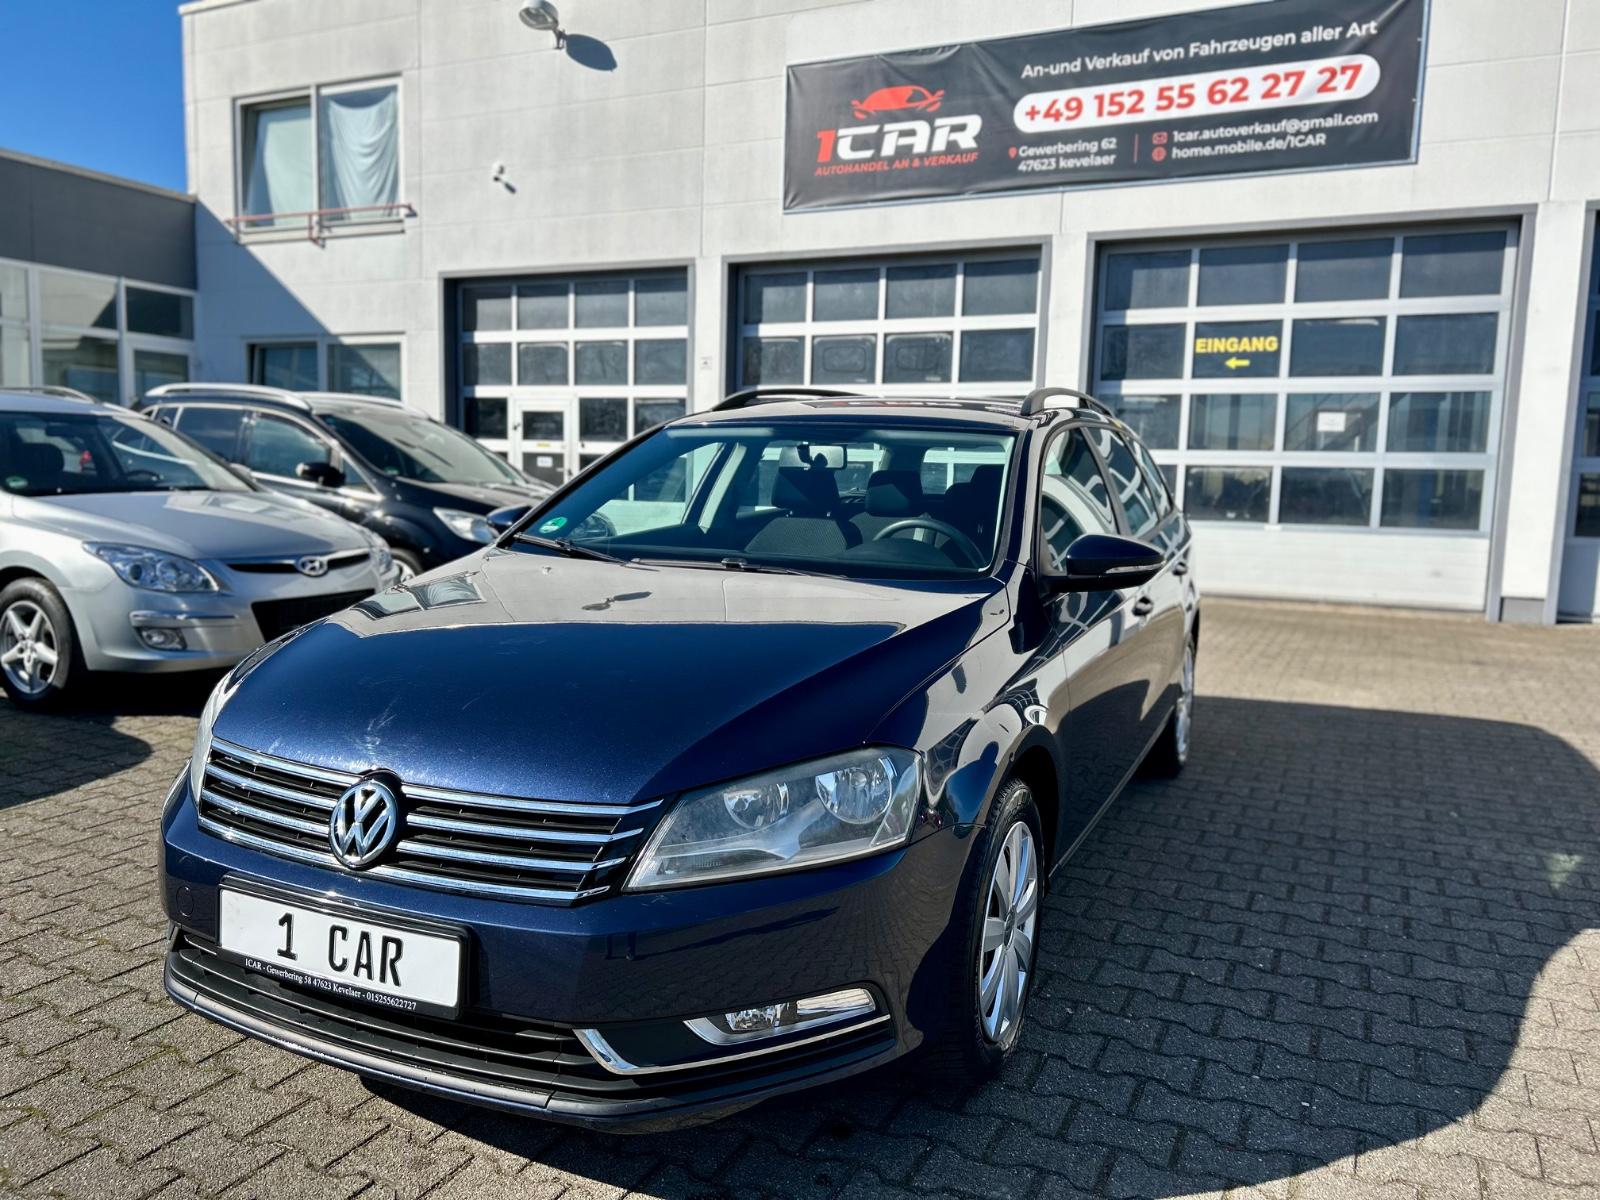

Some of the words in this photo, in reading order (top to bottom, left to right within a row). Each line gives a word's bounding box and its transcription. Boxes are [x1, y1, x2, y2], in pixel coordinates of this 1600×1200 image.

[1021, 58, 1082, 79] An-und
[1085, 48, 1150, 71] Verkauf
[1153, 46, 1184, 62] von
[1189, 32, 1296, 58] Fahrzeugen
[1301, 26, 1343, 44] aller
[1346, 20, 1378, 38] Art
[1025, 96, 1084, 122] +49
[1094, 89, 1145, 118] 152
[1155, 83, 1196, 111] 55
[1207, 76, 1249, 105] 62
[1261, 70, 1306, 100] 27
[1316, 63, 1363, 94] 27
[1173, 111, 1378, 142] 1car.autoverkauf@gmail.com
[1018, 140, 1098, 158] Gewerbering
[1101, 137, 1117, 150] 62
[1018, 157, 1056, 172] 47623
[1059, 153, 1117, 168] kevelaer
[814, 160, 889, 177] AUTOHANDEL
[892, 159, 910, 170] AN
[912, 158, 921, 169] &
[923, 152, 980, 167] VERKAUF
[1195, 336, 1278, 353] EINGANG
[277, 912, 297, 960] 1
[328, 923, 404, 987] CAR
[266, 964, 303, 984] Gewerbering
[304, 975, 312, 985] 58
[313, 977, 332, 990] 47623
[333, 983, 361, 998] Kevelaer
[366, 992, 417, 1010] 015255622727
